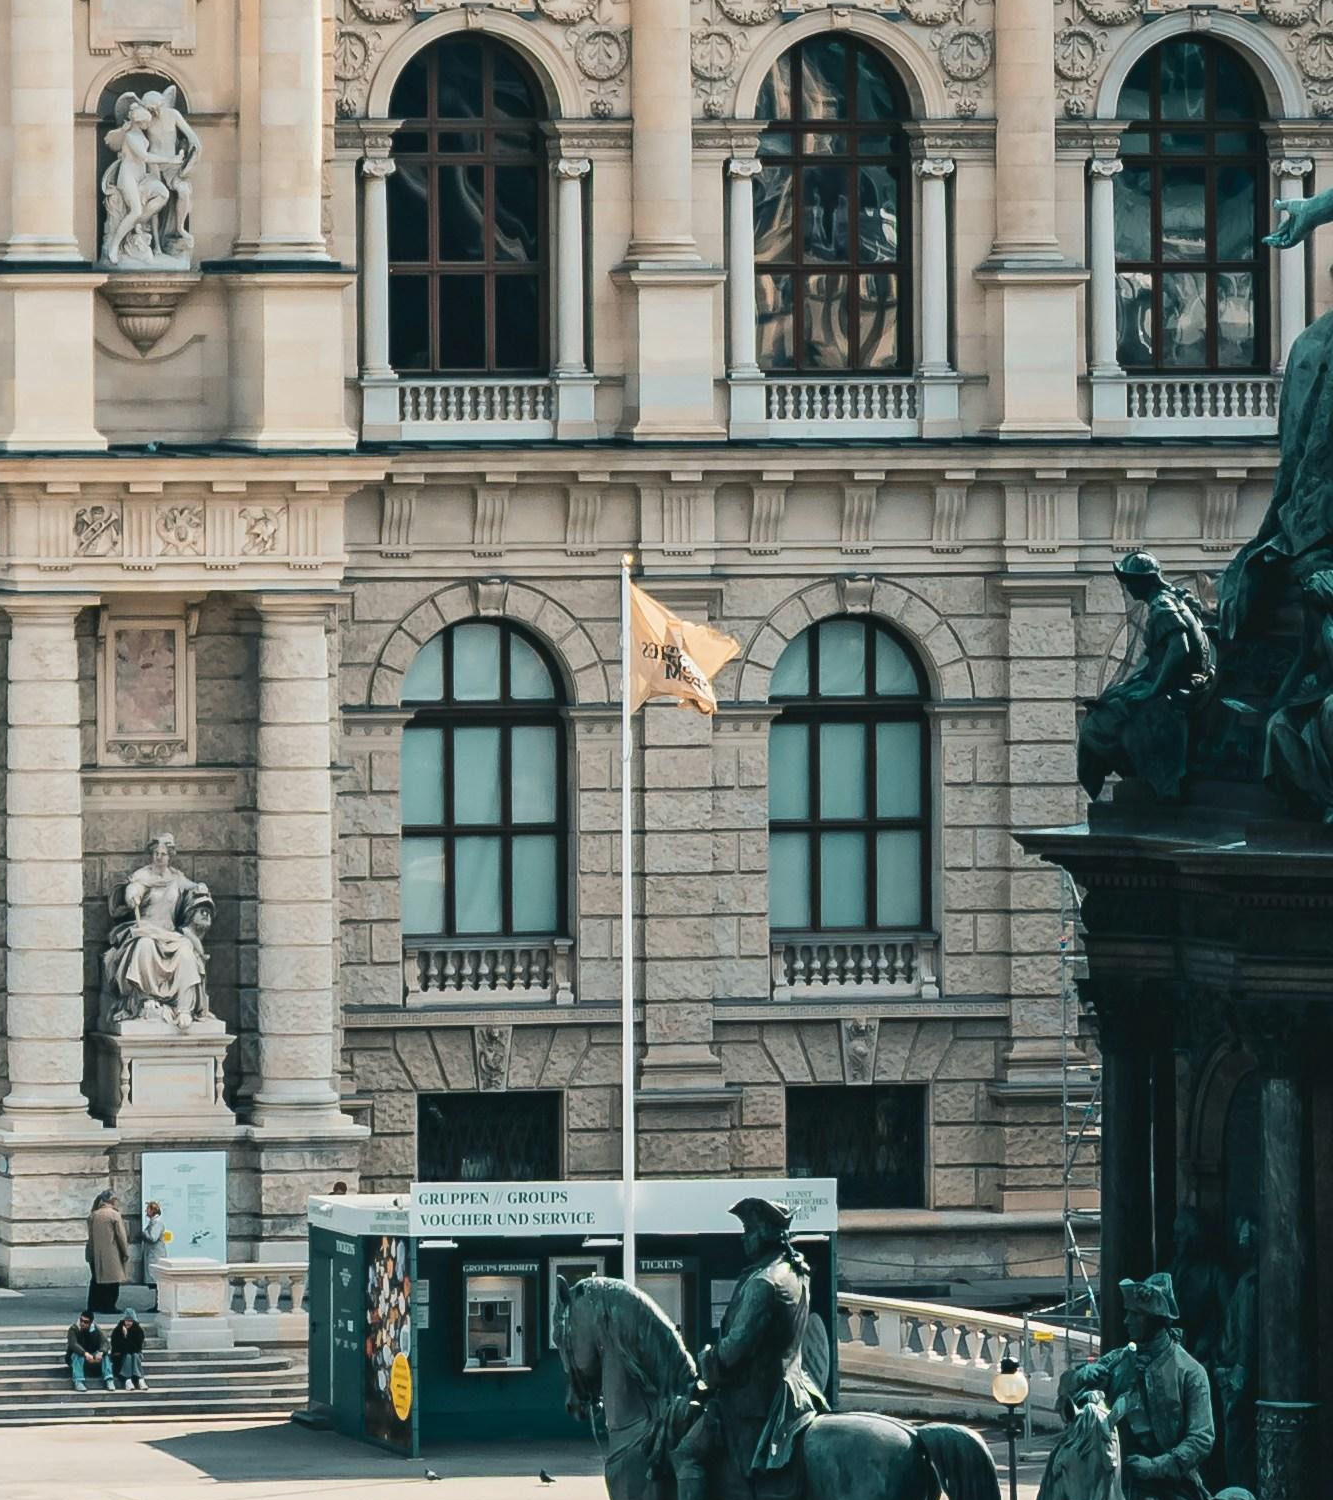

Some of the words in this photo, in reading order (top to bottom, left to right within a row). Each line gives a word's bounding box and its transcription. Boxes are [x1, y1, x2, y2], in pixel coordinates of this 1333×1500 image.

[418, 1192, 489, 1206] GRUPPEN
[507, 1191, 569, 1205] GROUPS
[420, 1212, 493, 1227] VOUCHER
[497, 1212, 529, 1226] UND
[532, 1211, 595, 1226] SERVICE
[462, 1264, 497, 1273] GROUPS
[640, 1260, 684, 1270] TICKETS
